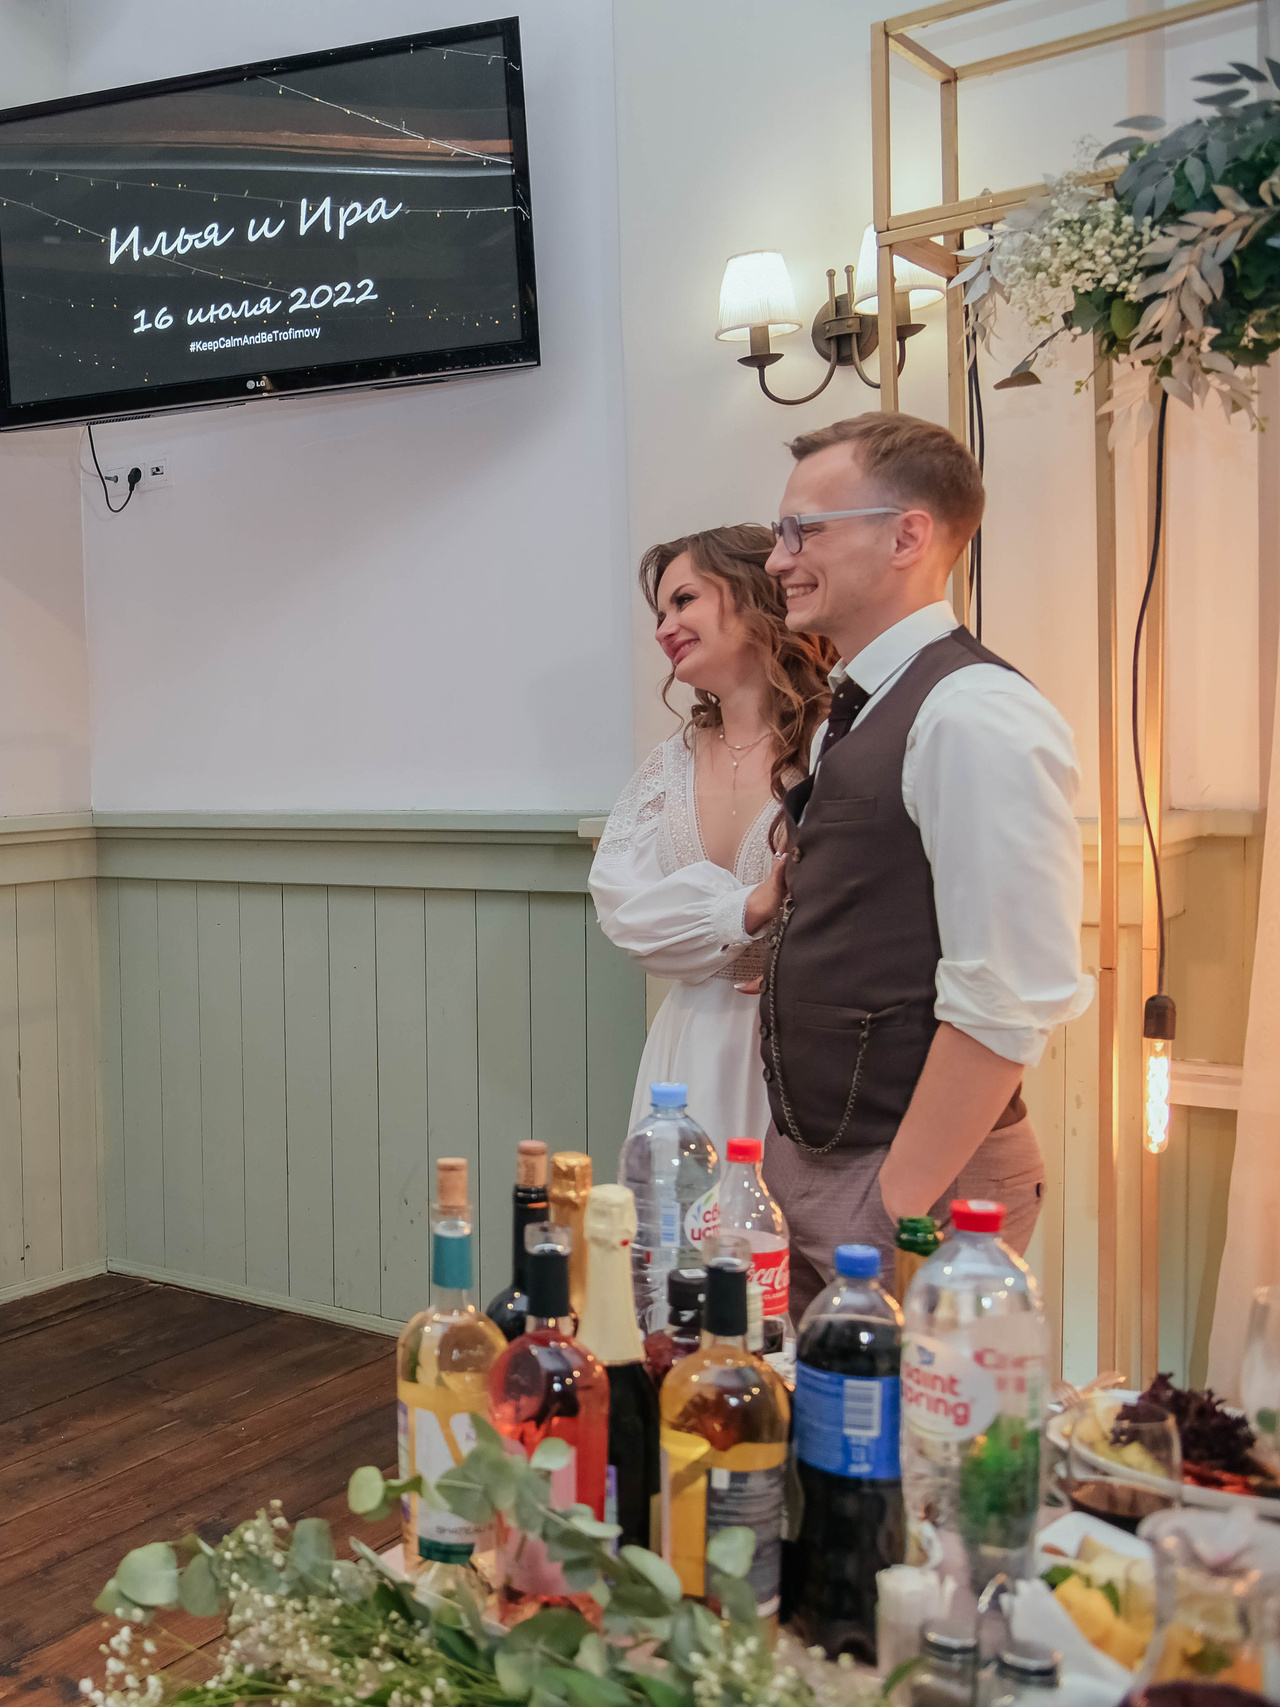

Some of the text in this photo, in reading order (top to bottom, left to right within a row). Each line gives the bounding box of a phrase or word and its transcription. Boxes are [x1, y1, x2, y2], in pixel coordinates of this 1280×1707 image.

[108, 195, 404, 265] Илья и Ира
[132, 278, 379, 334] 16 июля 2022
[189, 326, 322, 353] #KeepCalmAndBeTrofimovy
